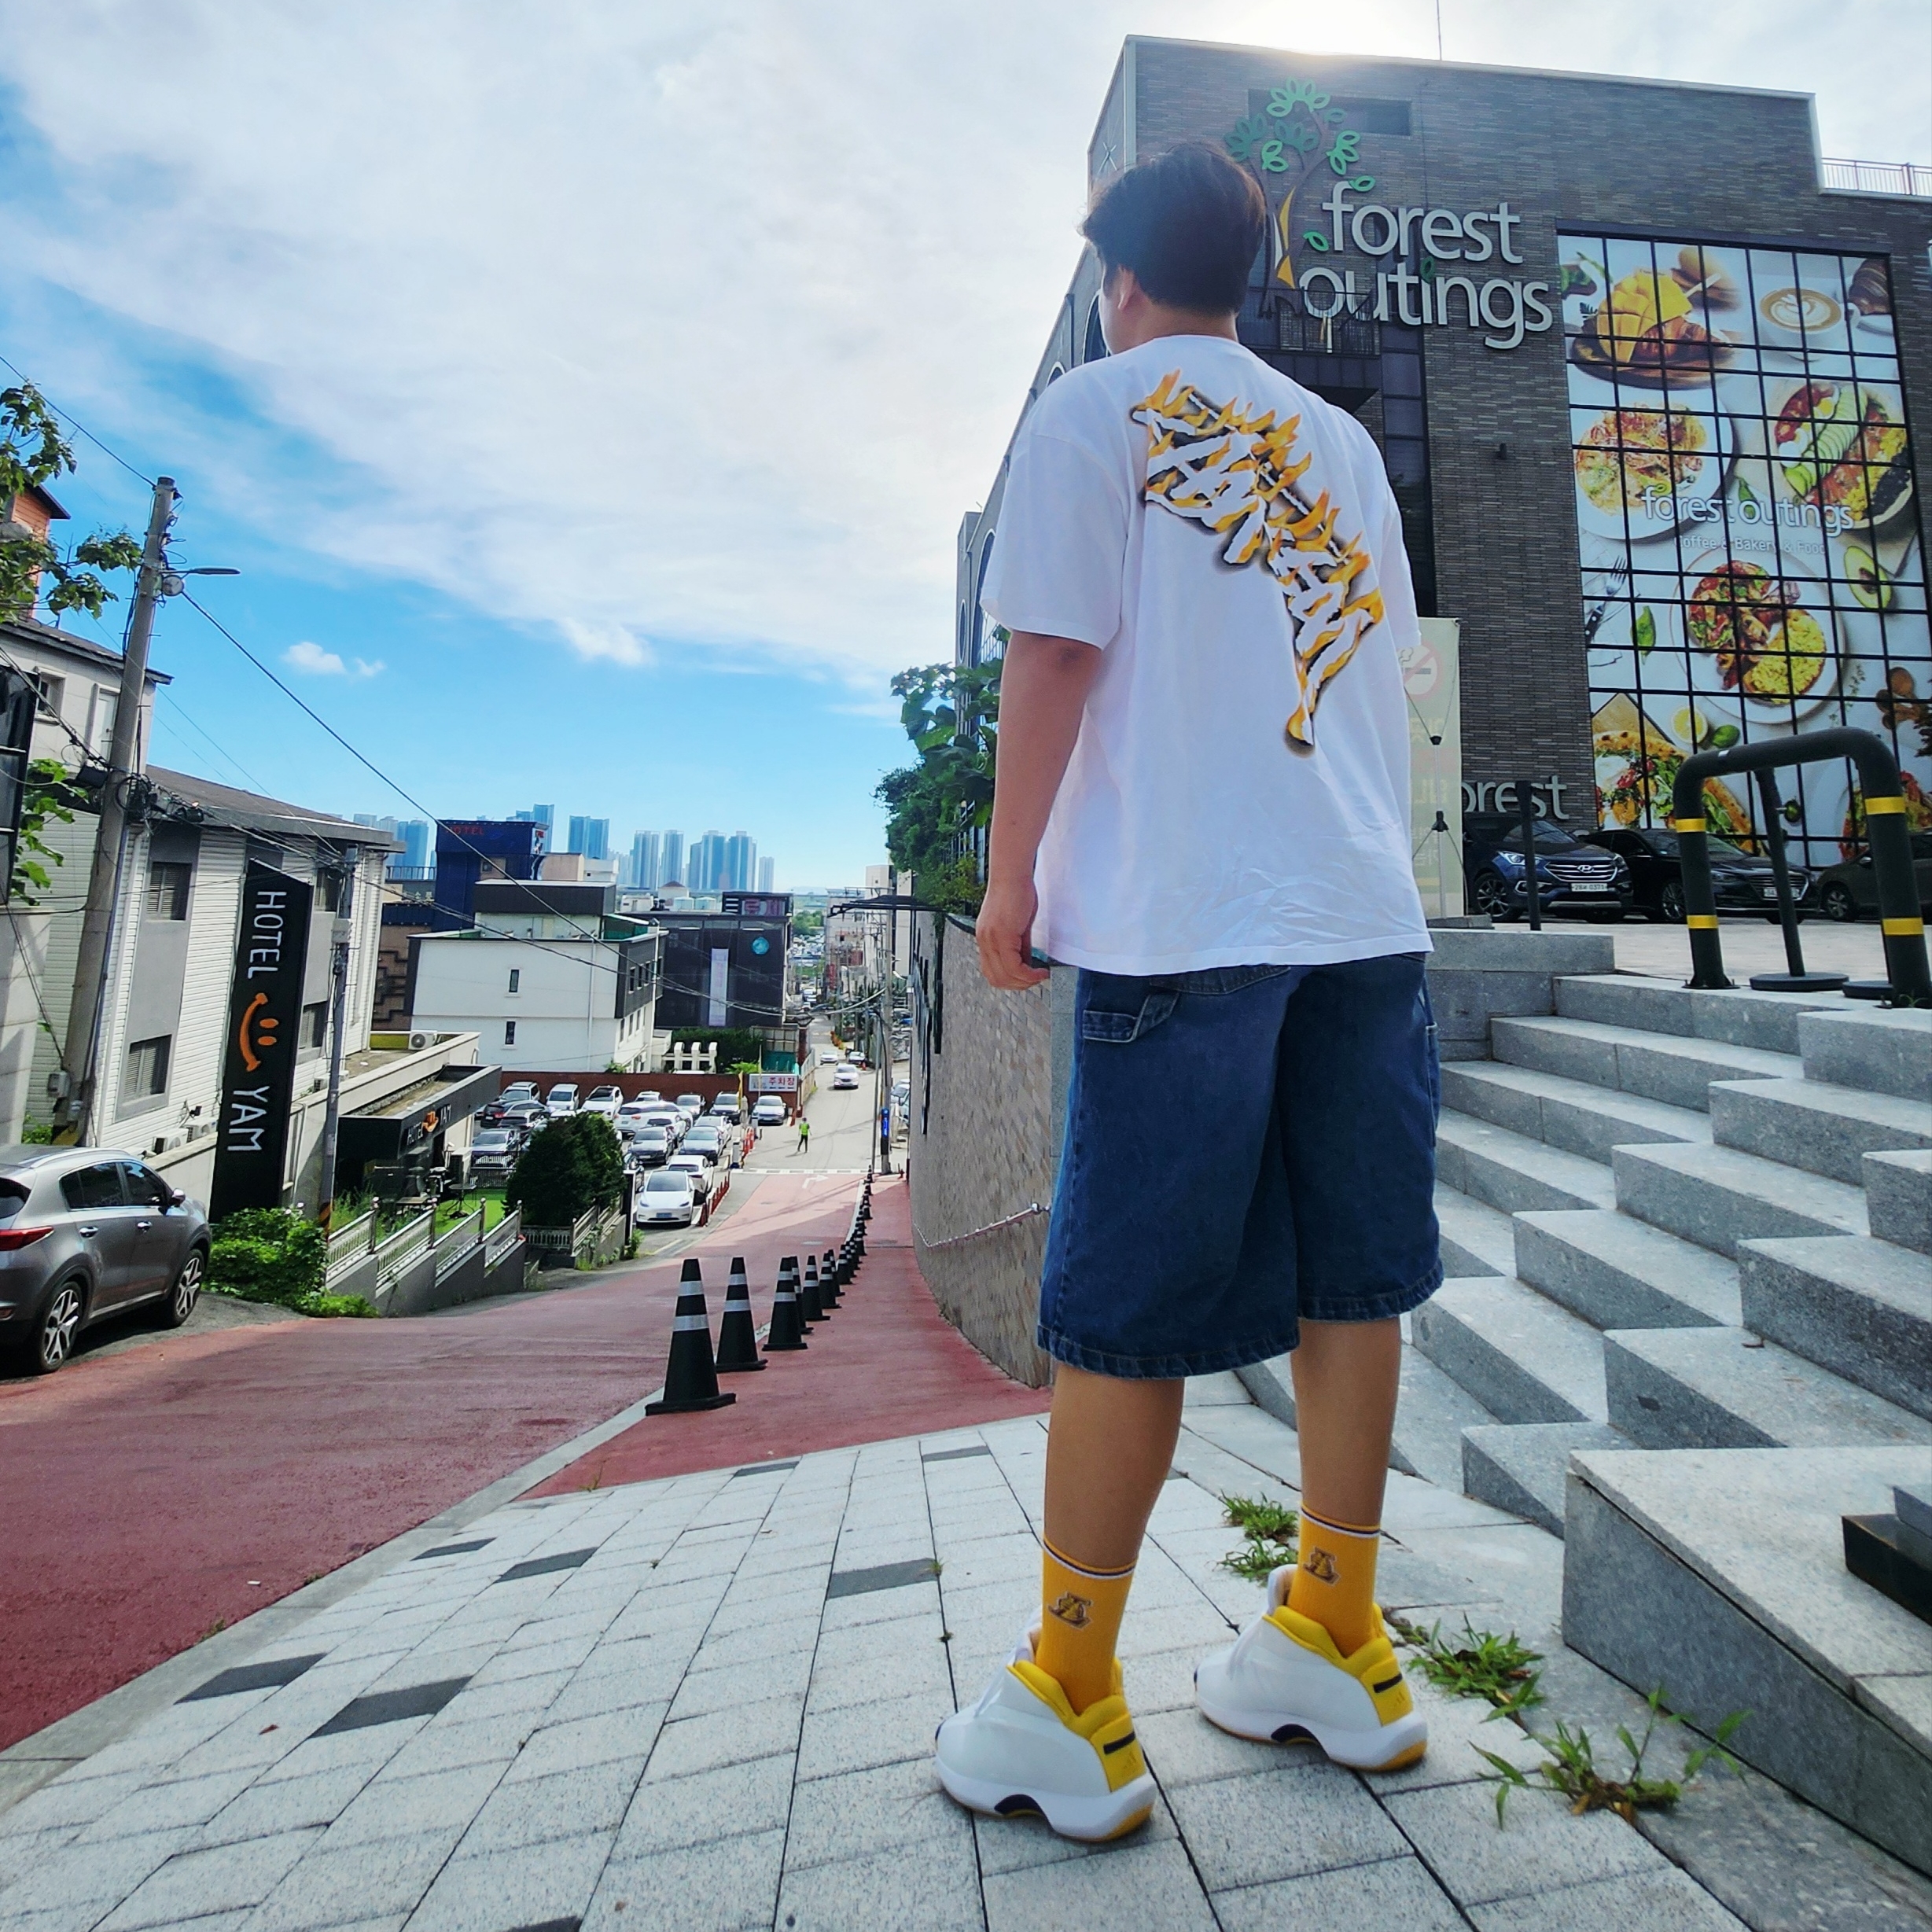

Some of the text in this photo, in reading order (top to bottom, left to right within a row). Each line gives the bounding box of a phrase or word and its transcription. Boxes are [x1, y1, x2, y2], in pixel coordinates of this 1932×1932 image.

[1322, 181, 1524, 263] forest
[1298, 262, 1554, 349] outings
[1641, 485, 1854, 538] forest outings
[1783, 541, 1793, 552] &
[227, 891, 287, 1151] HOTEL YAM
